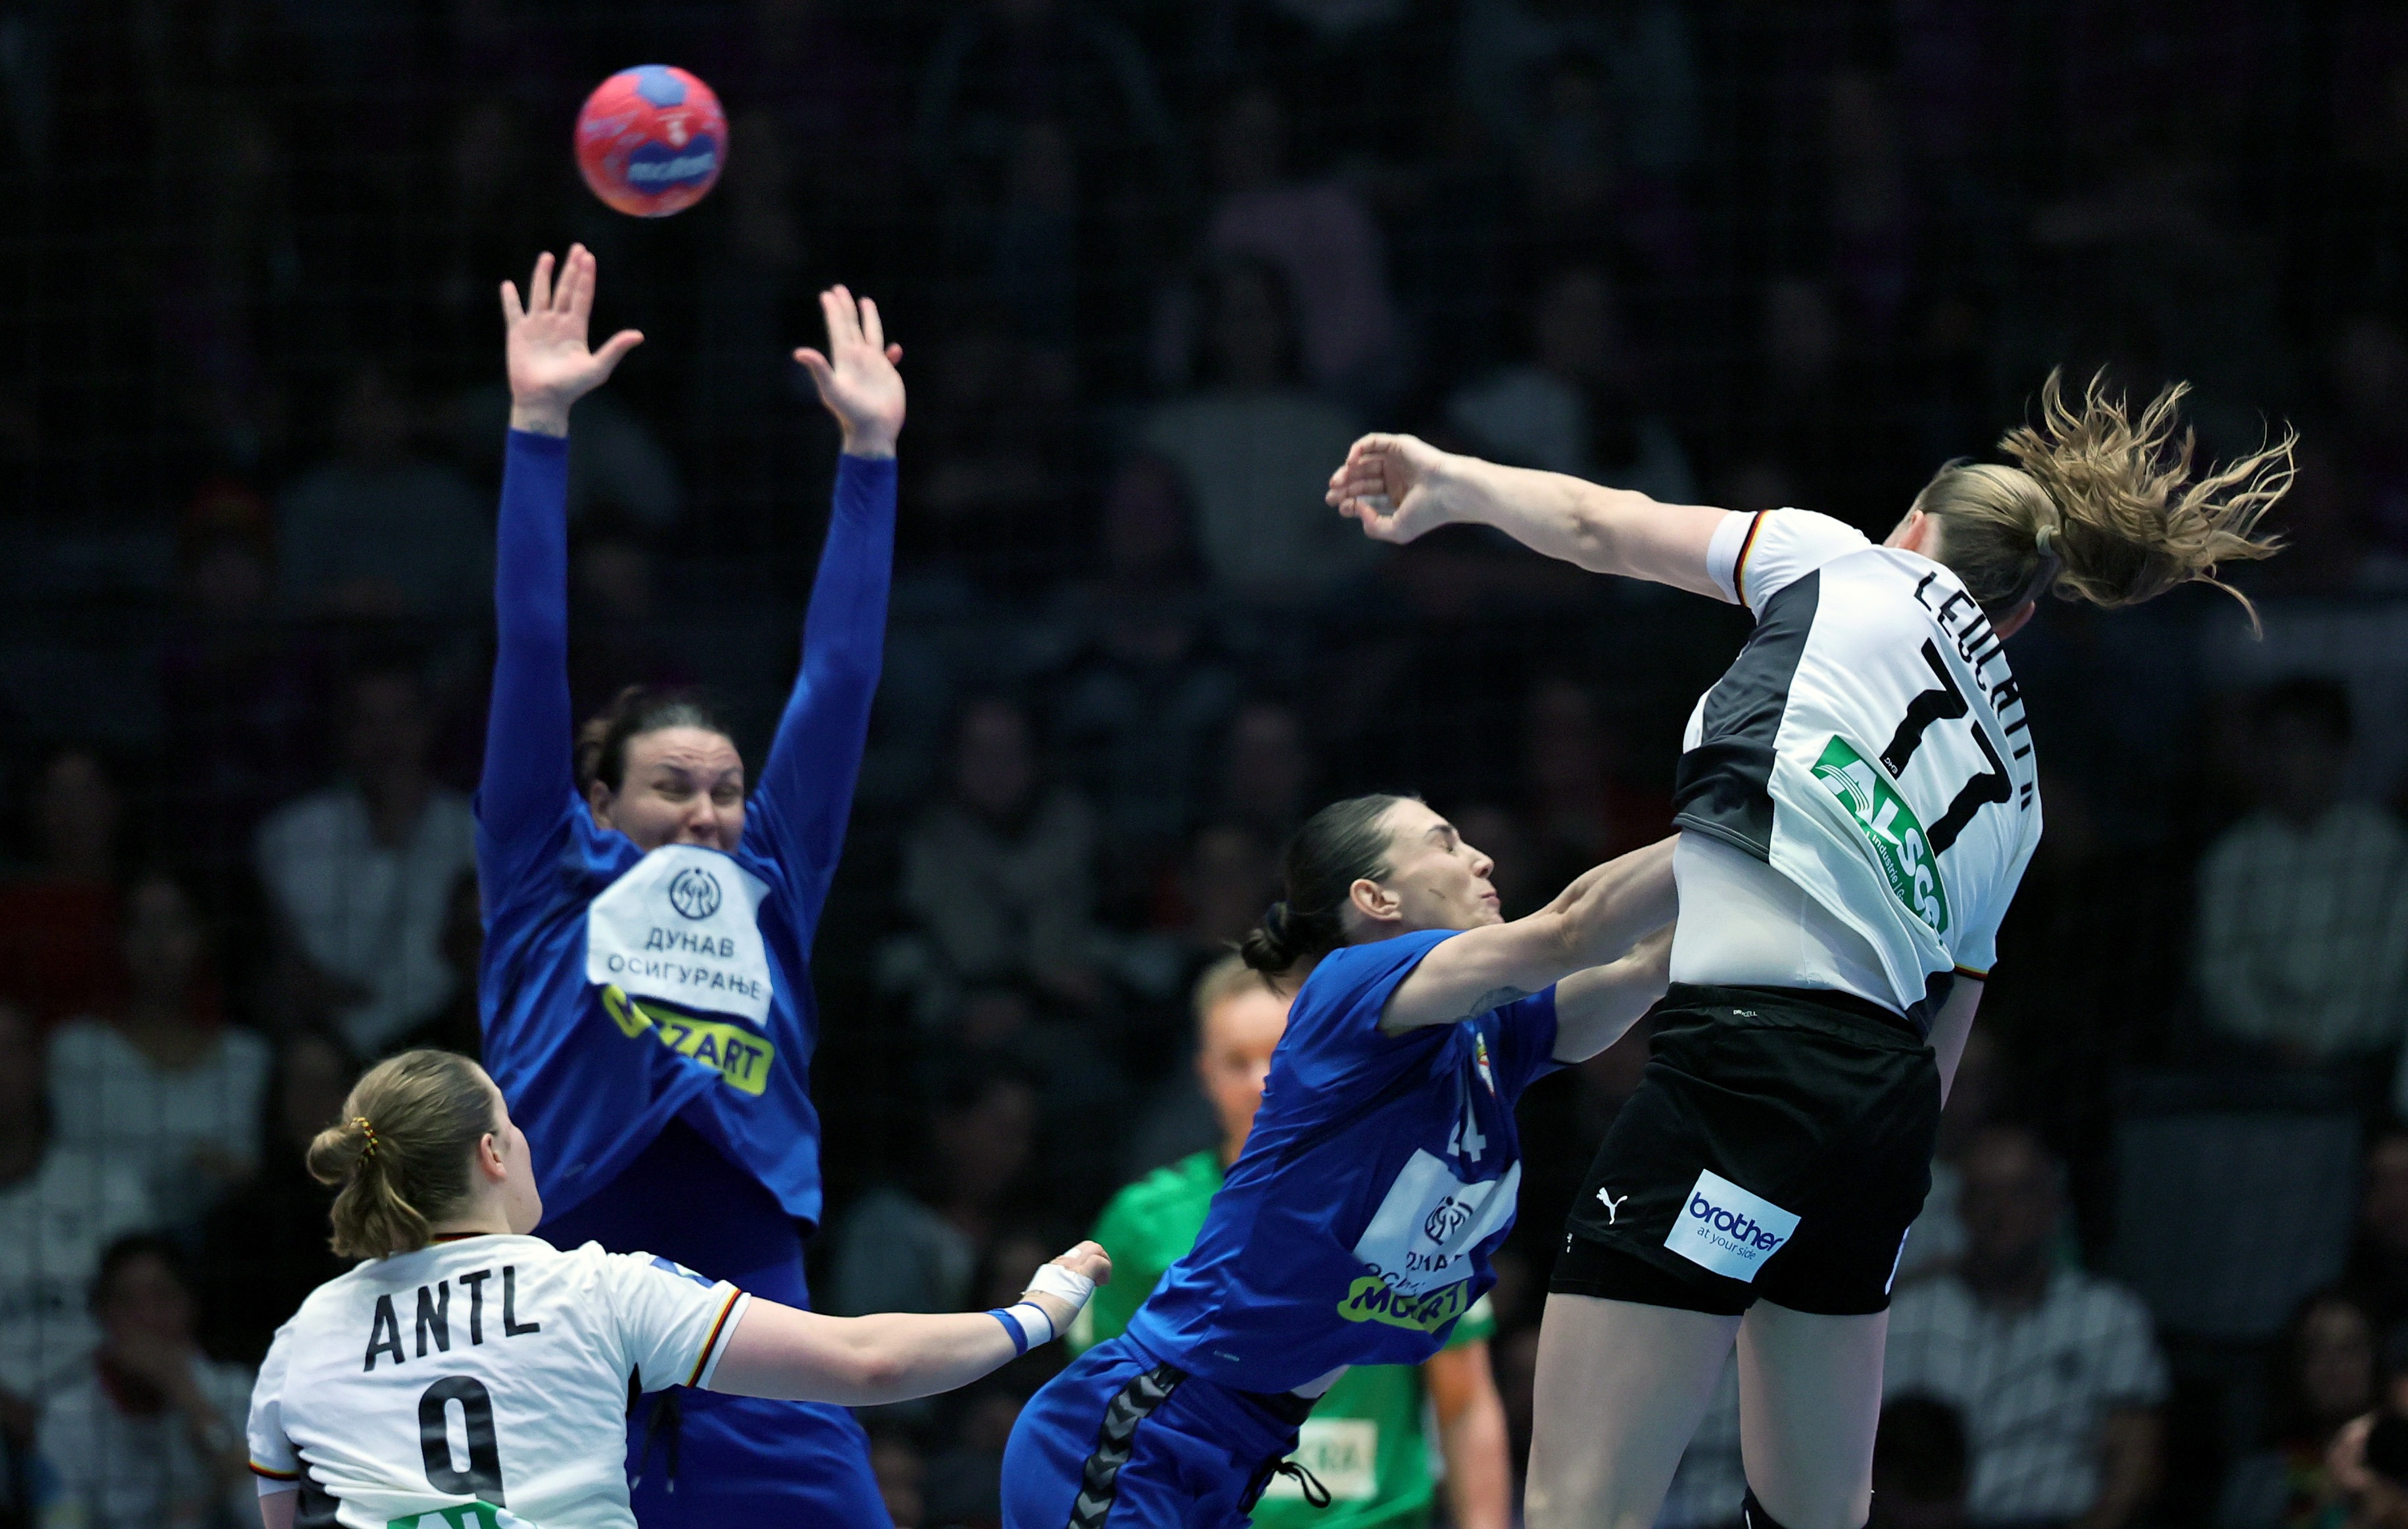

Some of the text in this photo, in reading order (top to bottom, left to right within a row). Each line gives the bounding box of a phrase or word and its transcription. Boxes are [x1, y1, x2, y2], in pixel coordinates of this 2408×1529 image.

[1879, 637, 2013, 859] 77
[1871, 834, 1898, 883] Industrie
[644, 926, 735, 958] ДУНАВ
[608, 953, 761, 1000] ОСИГУРАЊЕ
[1689, 1191, 1785, 1252] brother
[1697, 1227, 1756, 1260] at your side
[363, 1265, 541, 1373] ANTL
[418, 1376, 506, 1509] 9
